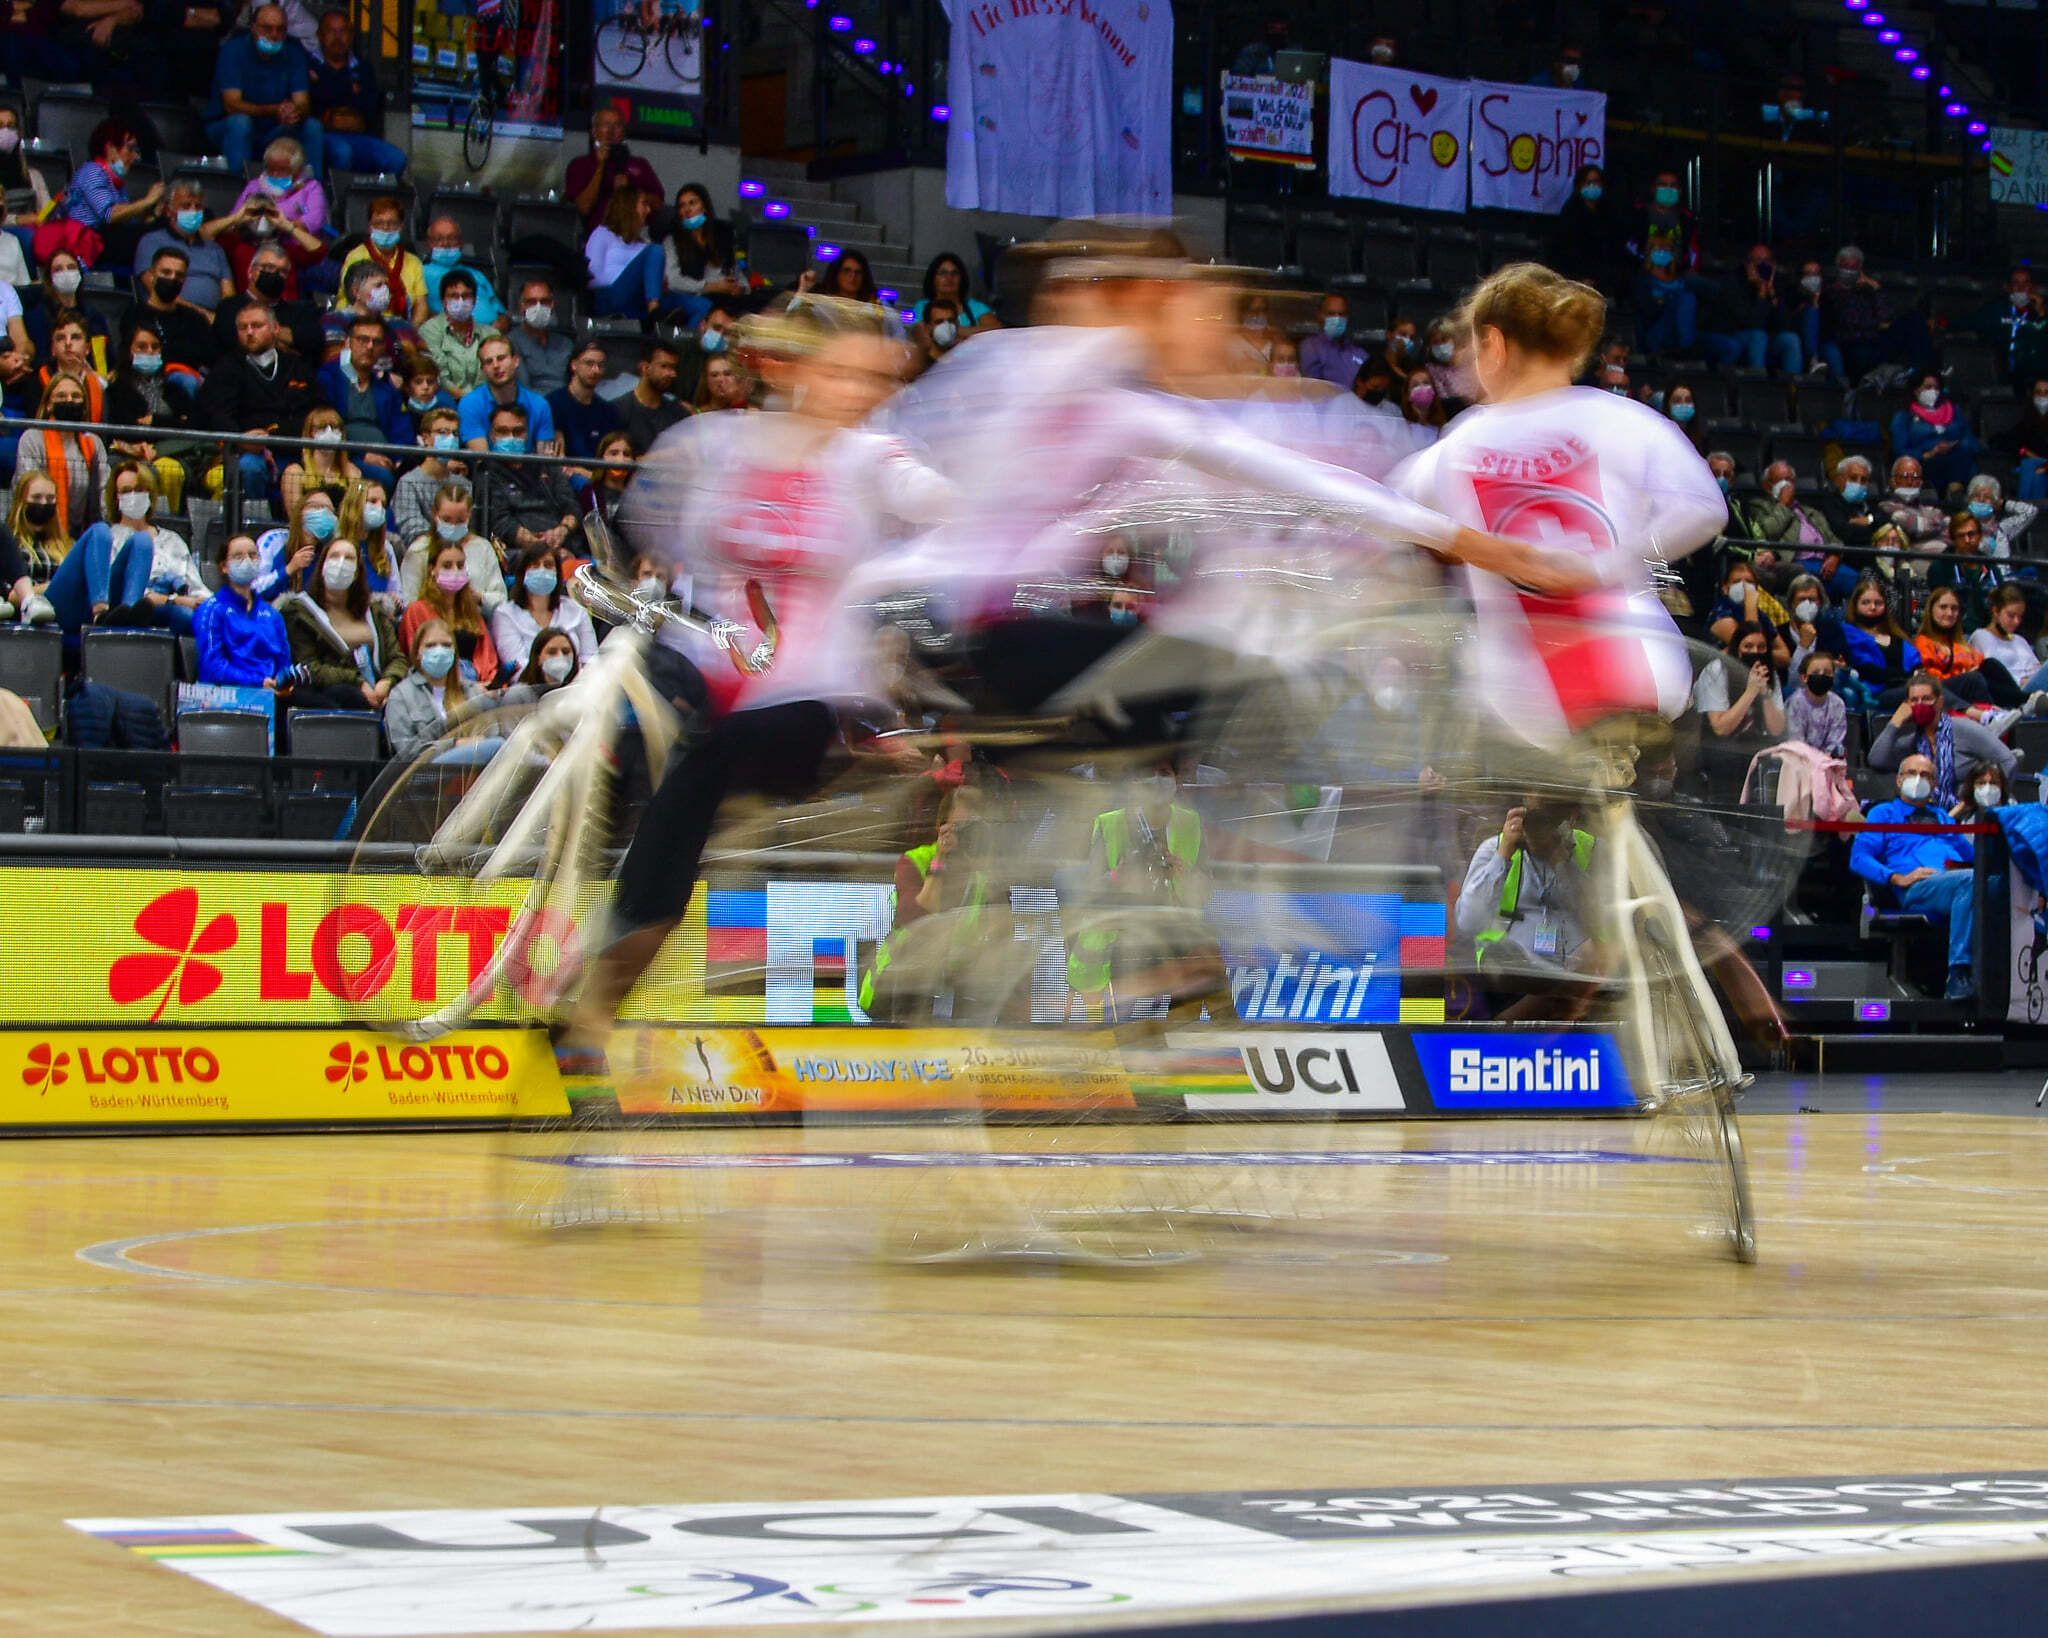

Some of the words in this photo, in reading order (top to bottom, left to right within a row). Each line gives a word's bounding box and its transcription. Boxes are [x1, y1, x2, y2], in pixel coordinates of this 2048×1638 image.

[507, 92, 557, 121] DICH
[1352, 90, 1458, 187] Caro
[1480, 94, 1601, 196] Sophie
[1990, 179, 2048, 204] DANI
[1476, 437, 1590, 480] SUISSE
[260, 902, 584, 1007] LOTTO
[1205, 952, 1378, 1019] ntini
[78, 1047, 220, 1084] LOTTO
[376, 1045, 509, 1080] LOTTO
[794, 1057, 896, 1082] HOLIDAY
[910, 1058, 953, 1082] ICE
[1246, 1047, 1360, 1094] UCI
[1450, 1048, 1600, 1092] Santini
[90, 1094, 229, 1110] Baden-Württemberg
[388, 1090, 519, 1105] Baden-Württemberg
[1243, 1494, 1558, 1513] 2021
[1296, 1502, 1869, 1528] WORLD
[286, 1506, 1155, 1552] UCI
